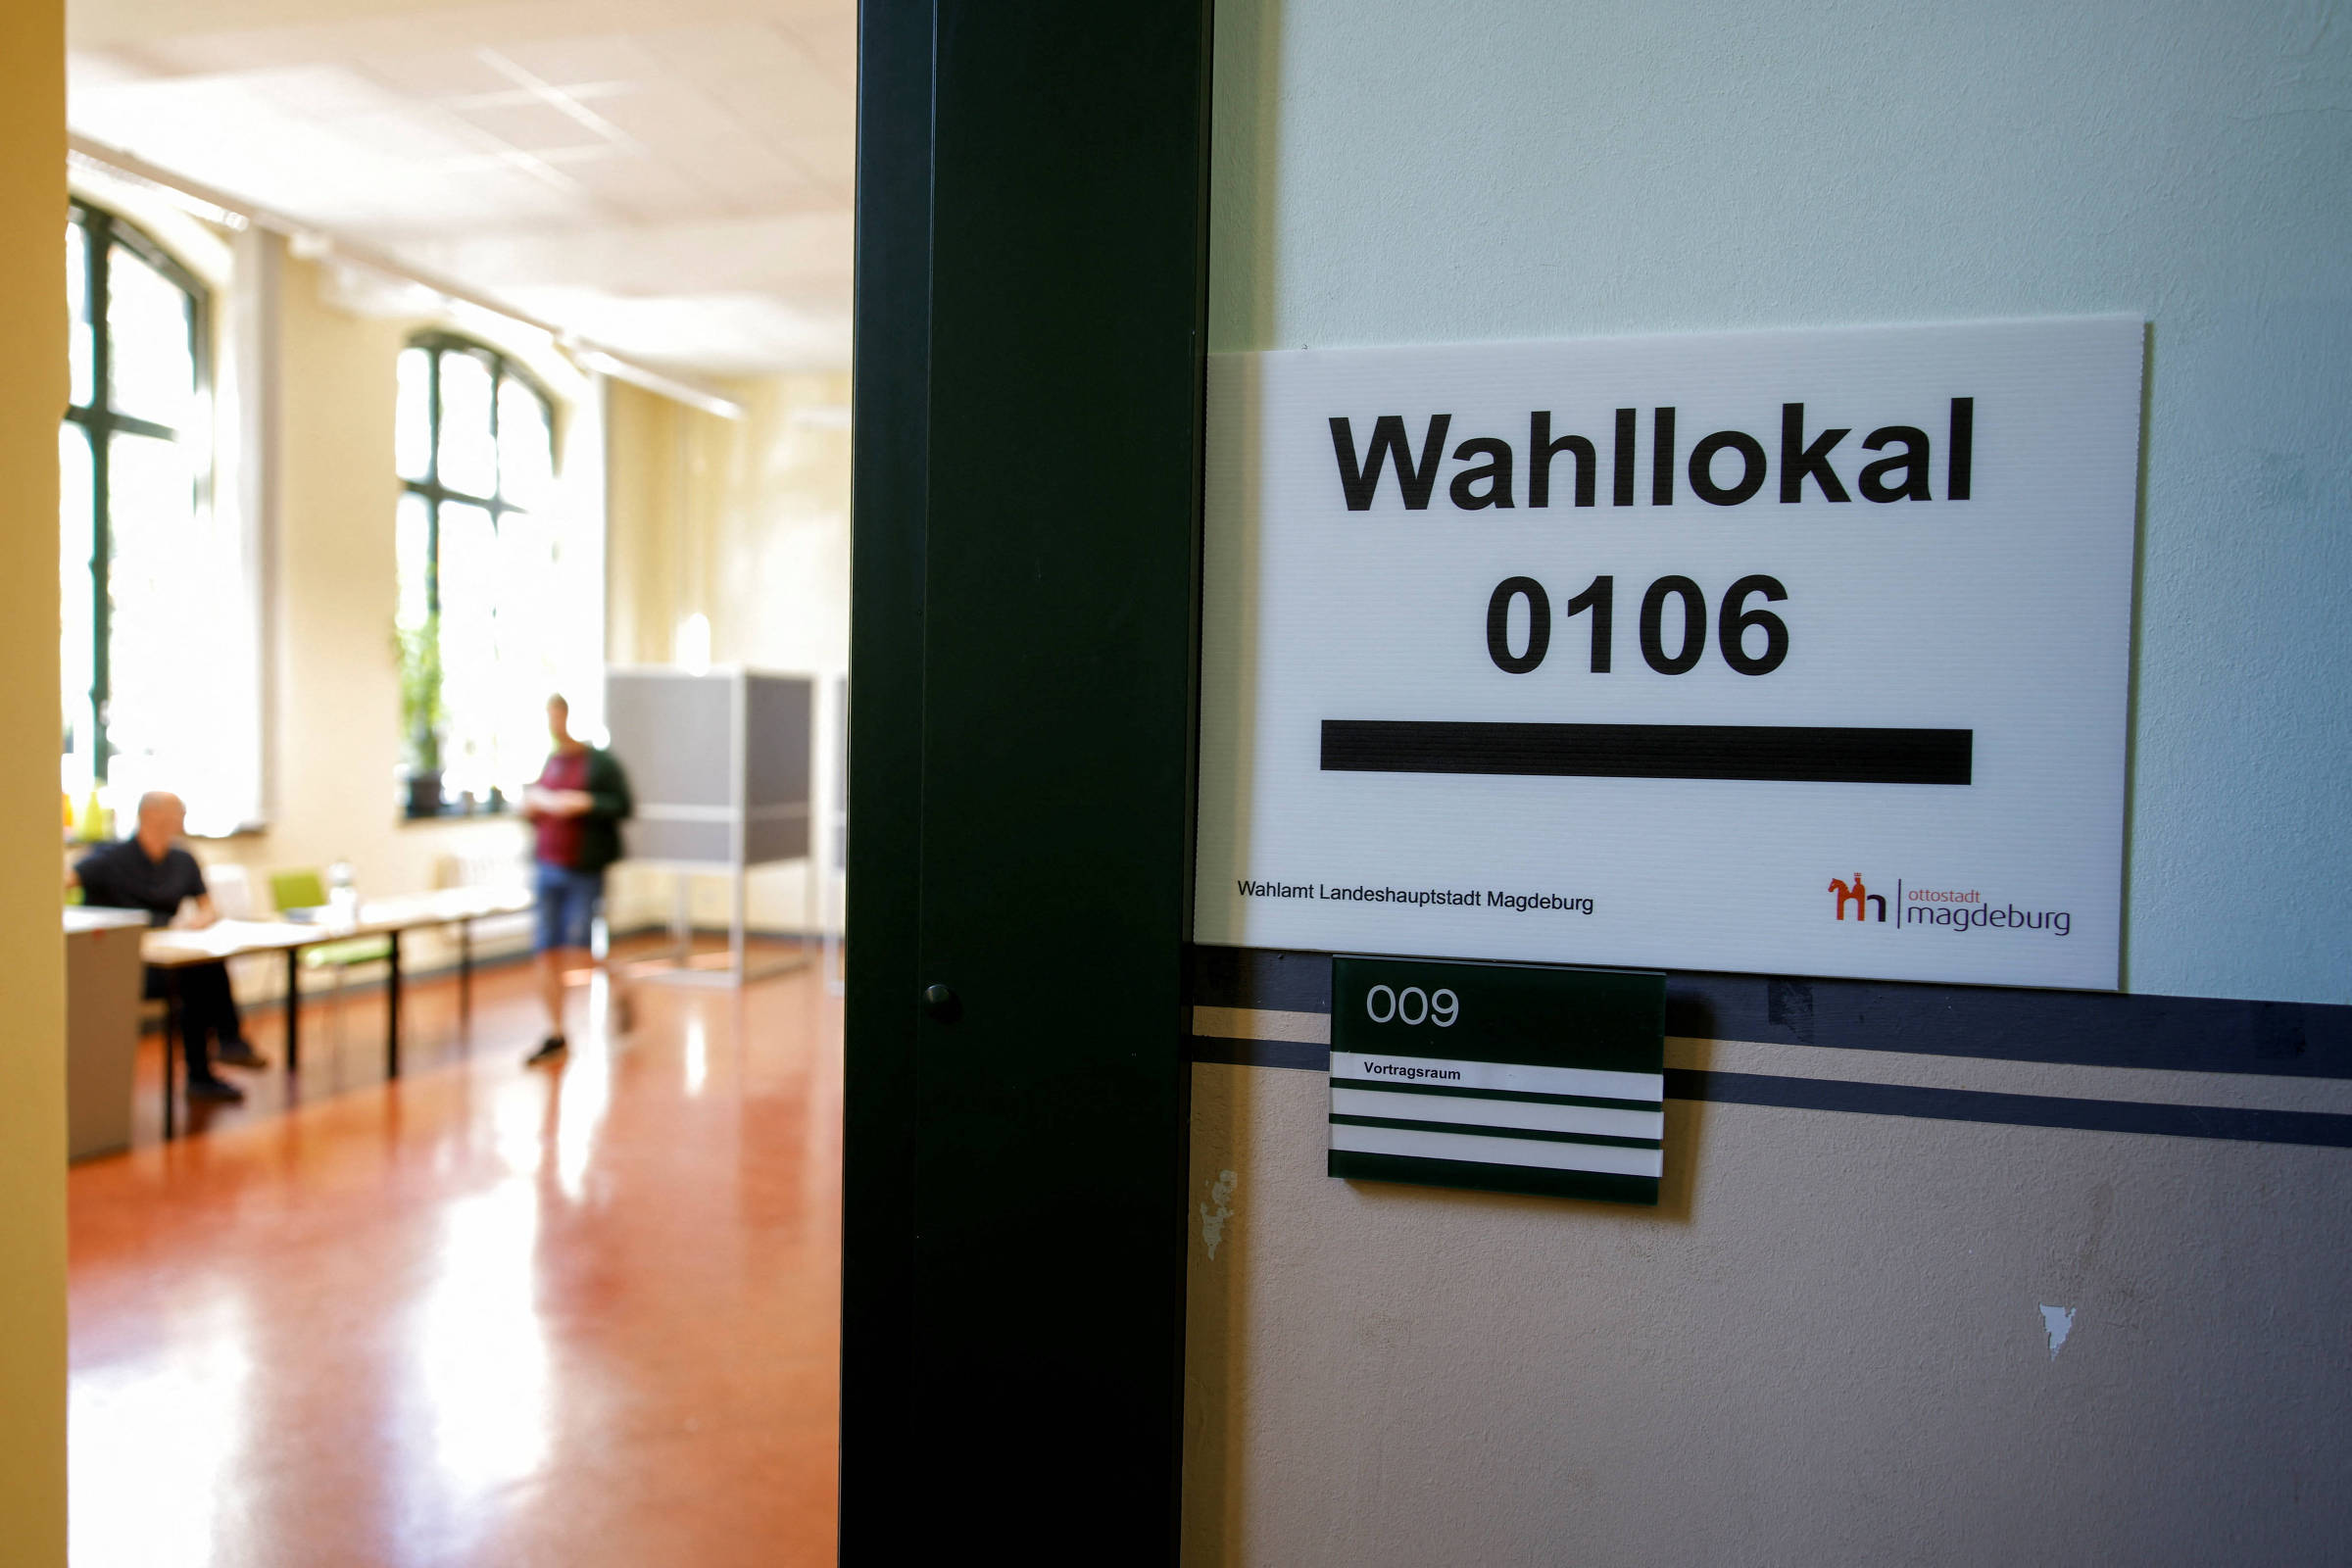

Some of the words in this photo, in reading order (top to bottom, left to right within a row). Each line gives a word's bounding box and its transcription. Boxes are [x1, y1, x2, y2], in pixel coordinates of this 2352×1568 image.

[1328, 396, 1975, 512] Wahllokal
[1486, 573, 1789, 677] 0106
[1236, 879, 1315, 900] Wahlamt
[1319, 883, 1482, 907] Landeshauptstadt
[1487, 890, 1593, 915] Magdeburg
[1907, 888, 1982, 905] ottostadt
[1907, 902, 2071, 937] magdeburg
[1366, 984, 1459, 1028] 009
[1363, 1060, 1461, 1081] Vortragsraum
